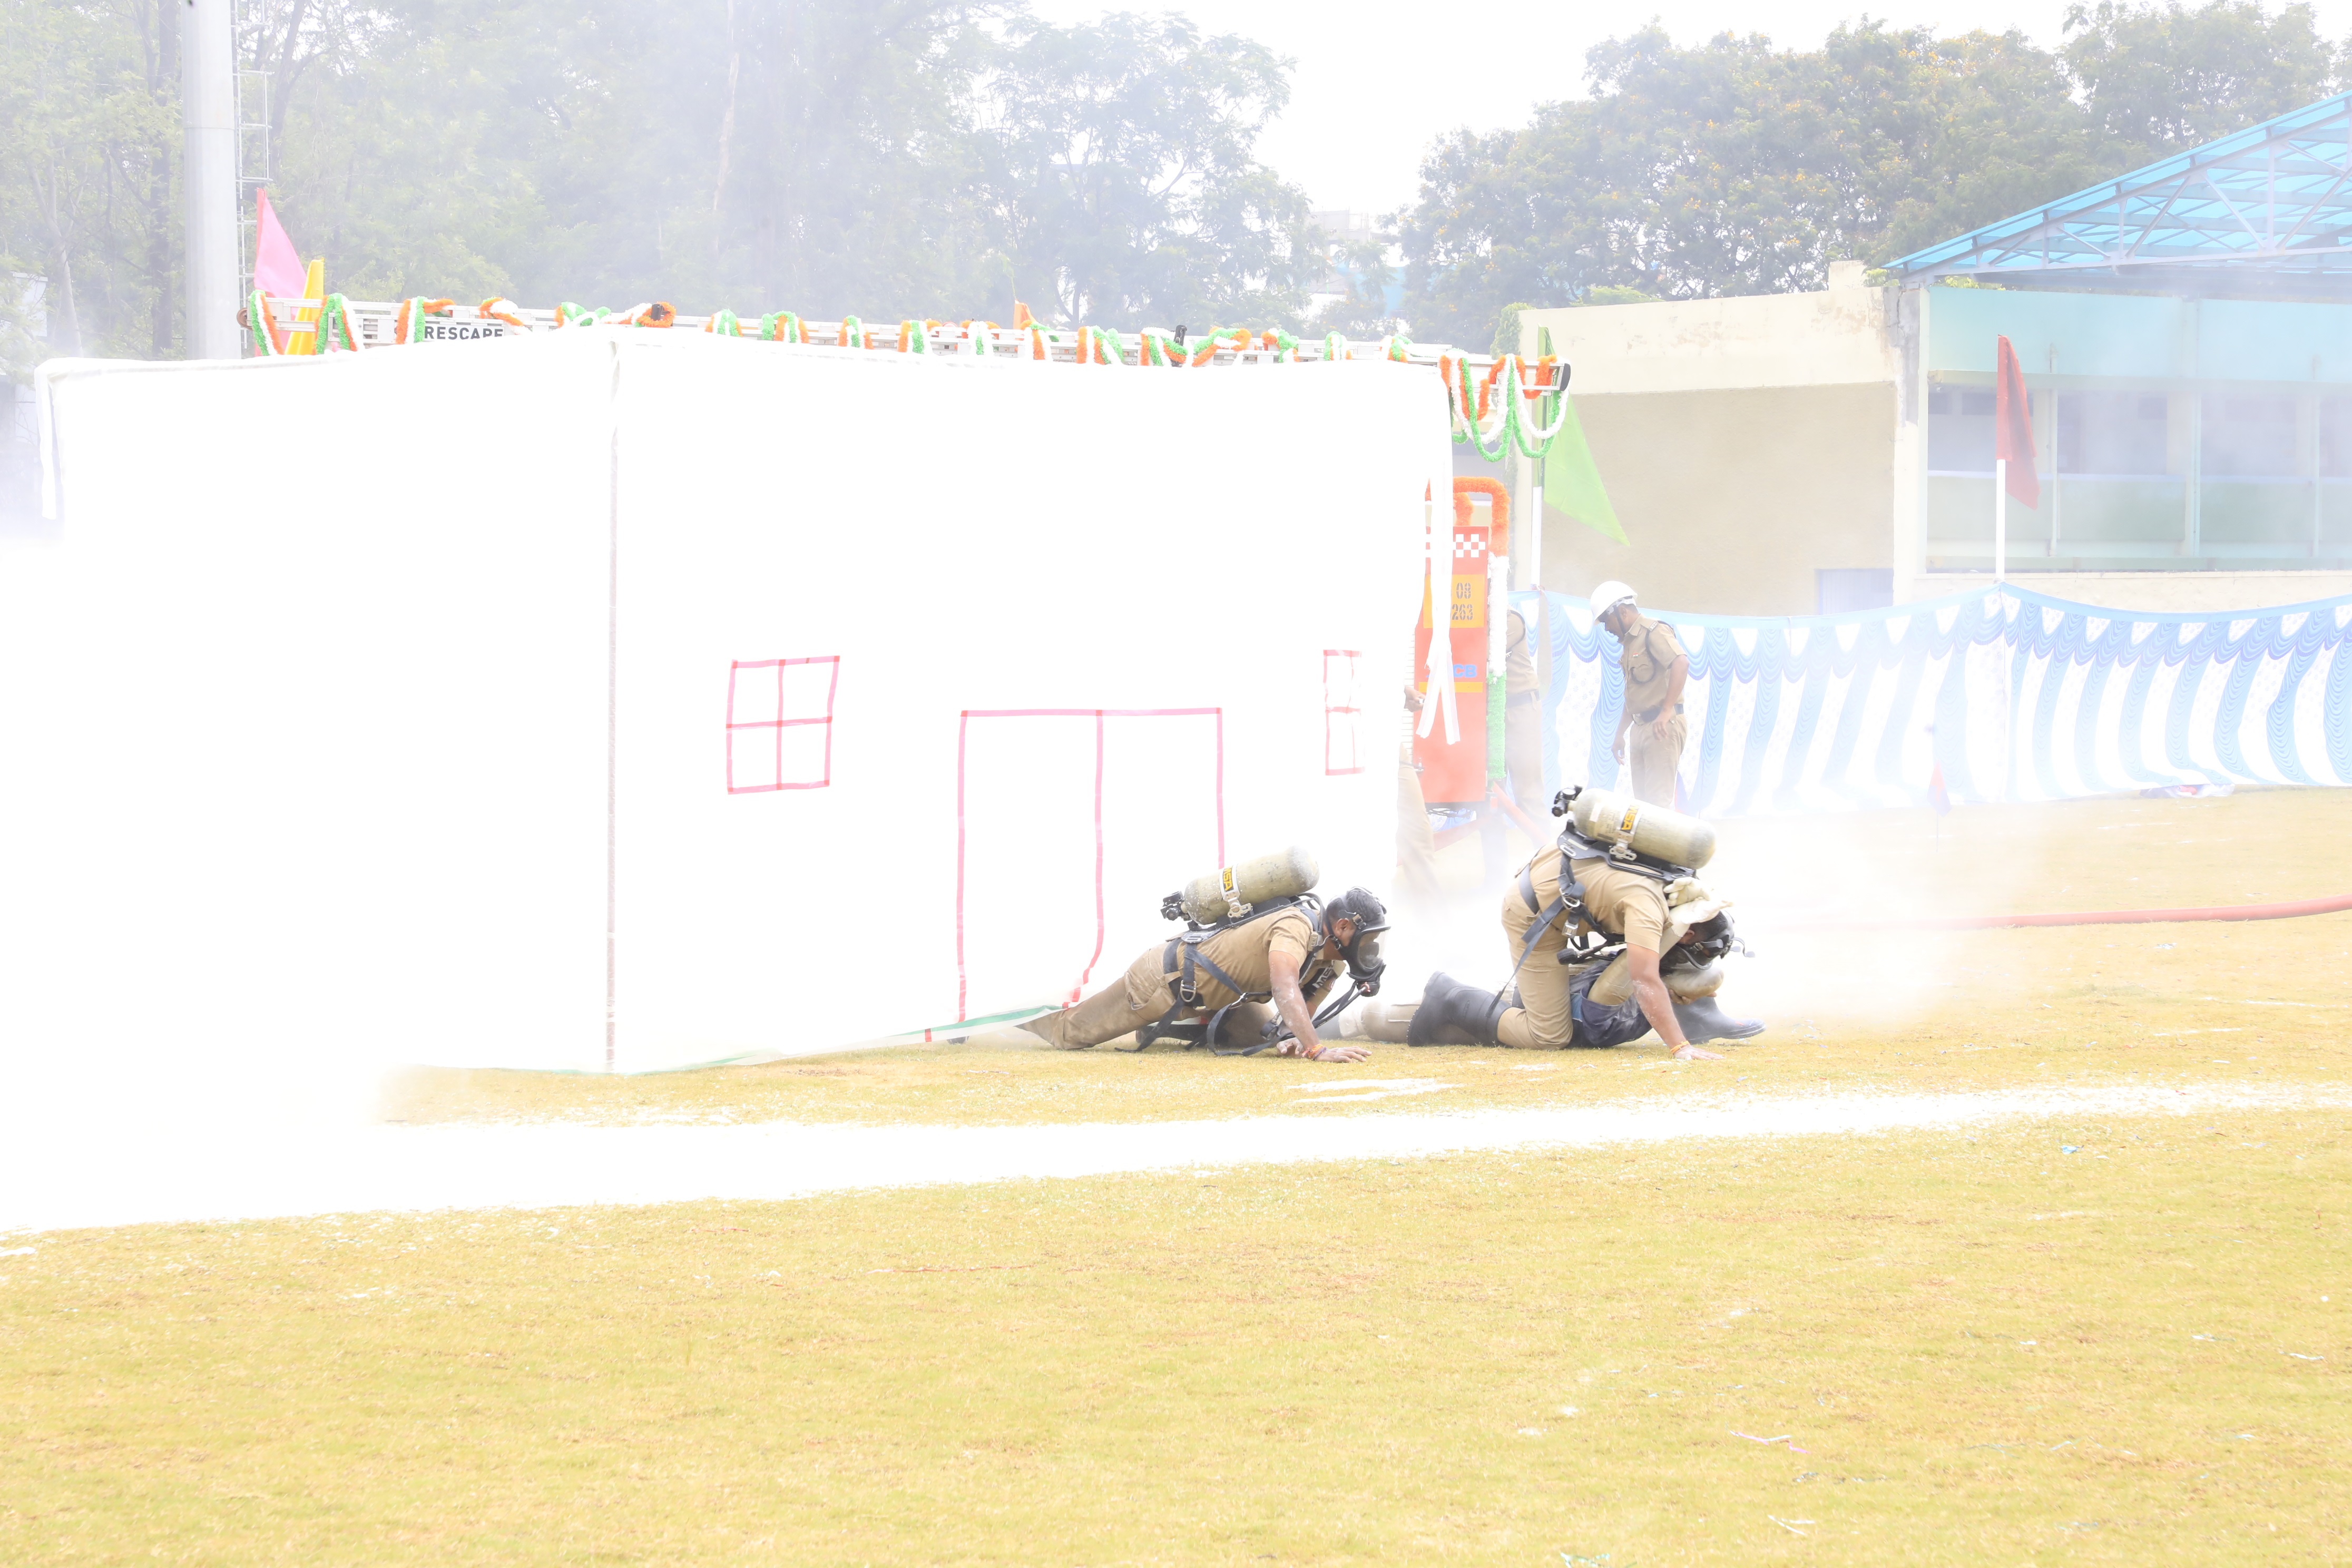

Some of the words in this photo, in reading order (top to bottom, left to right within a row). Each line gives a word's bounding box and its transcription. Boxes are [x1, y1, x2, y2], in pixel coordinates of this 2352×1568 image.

[1456, 582, 1471, 599] 08
[1621, 805, 1640, 830] MSA
[1223, 867, 1232, 891] MSA
